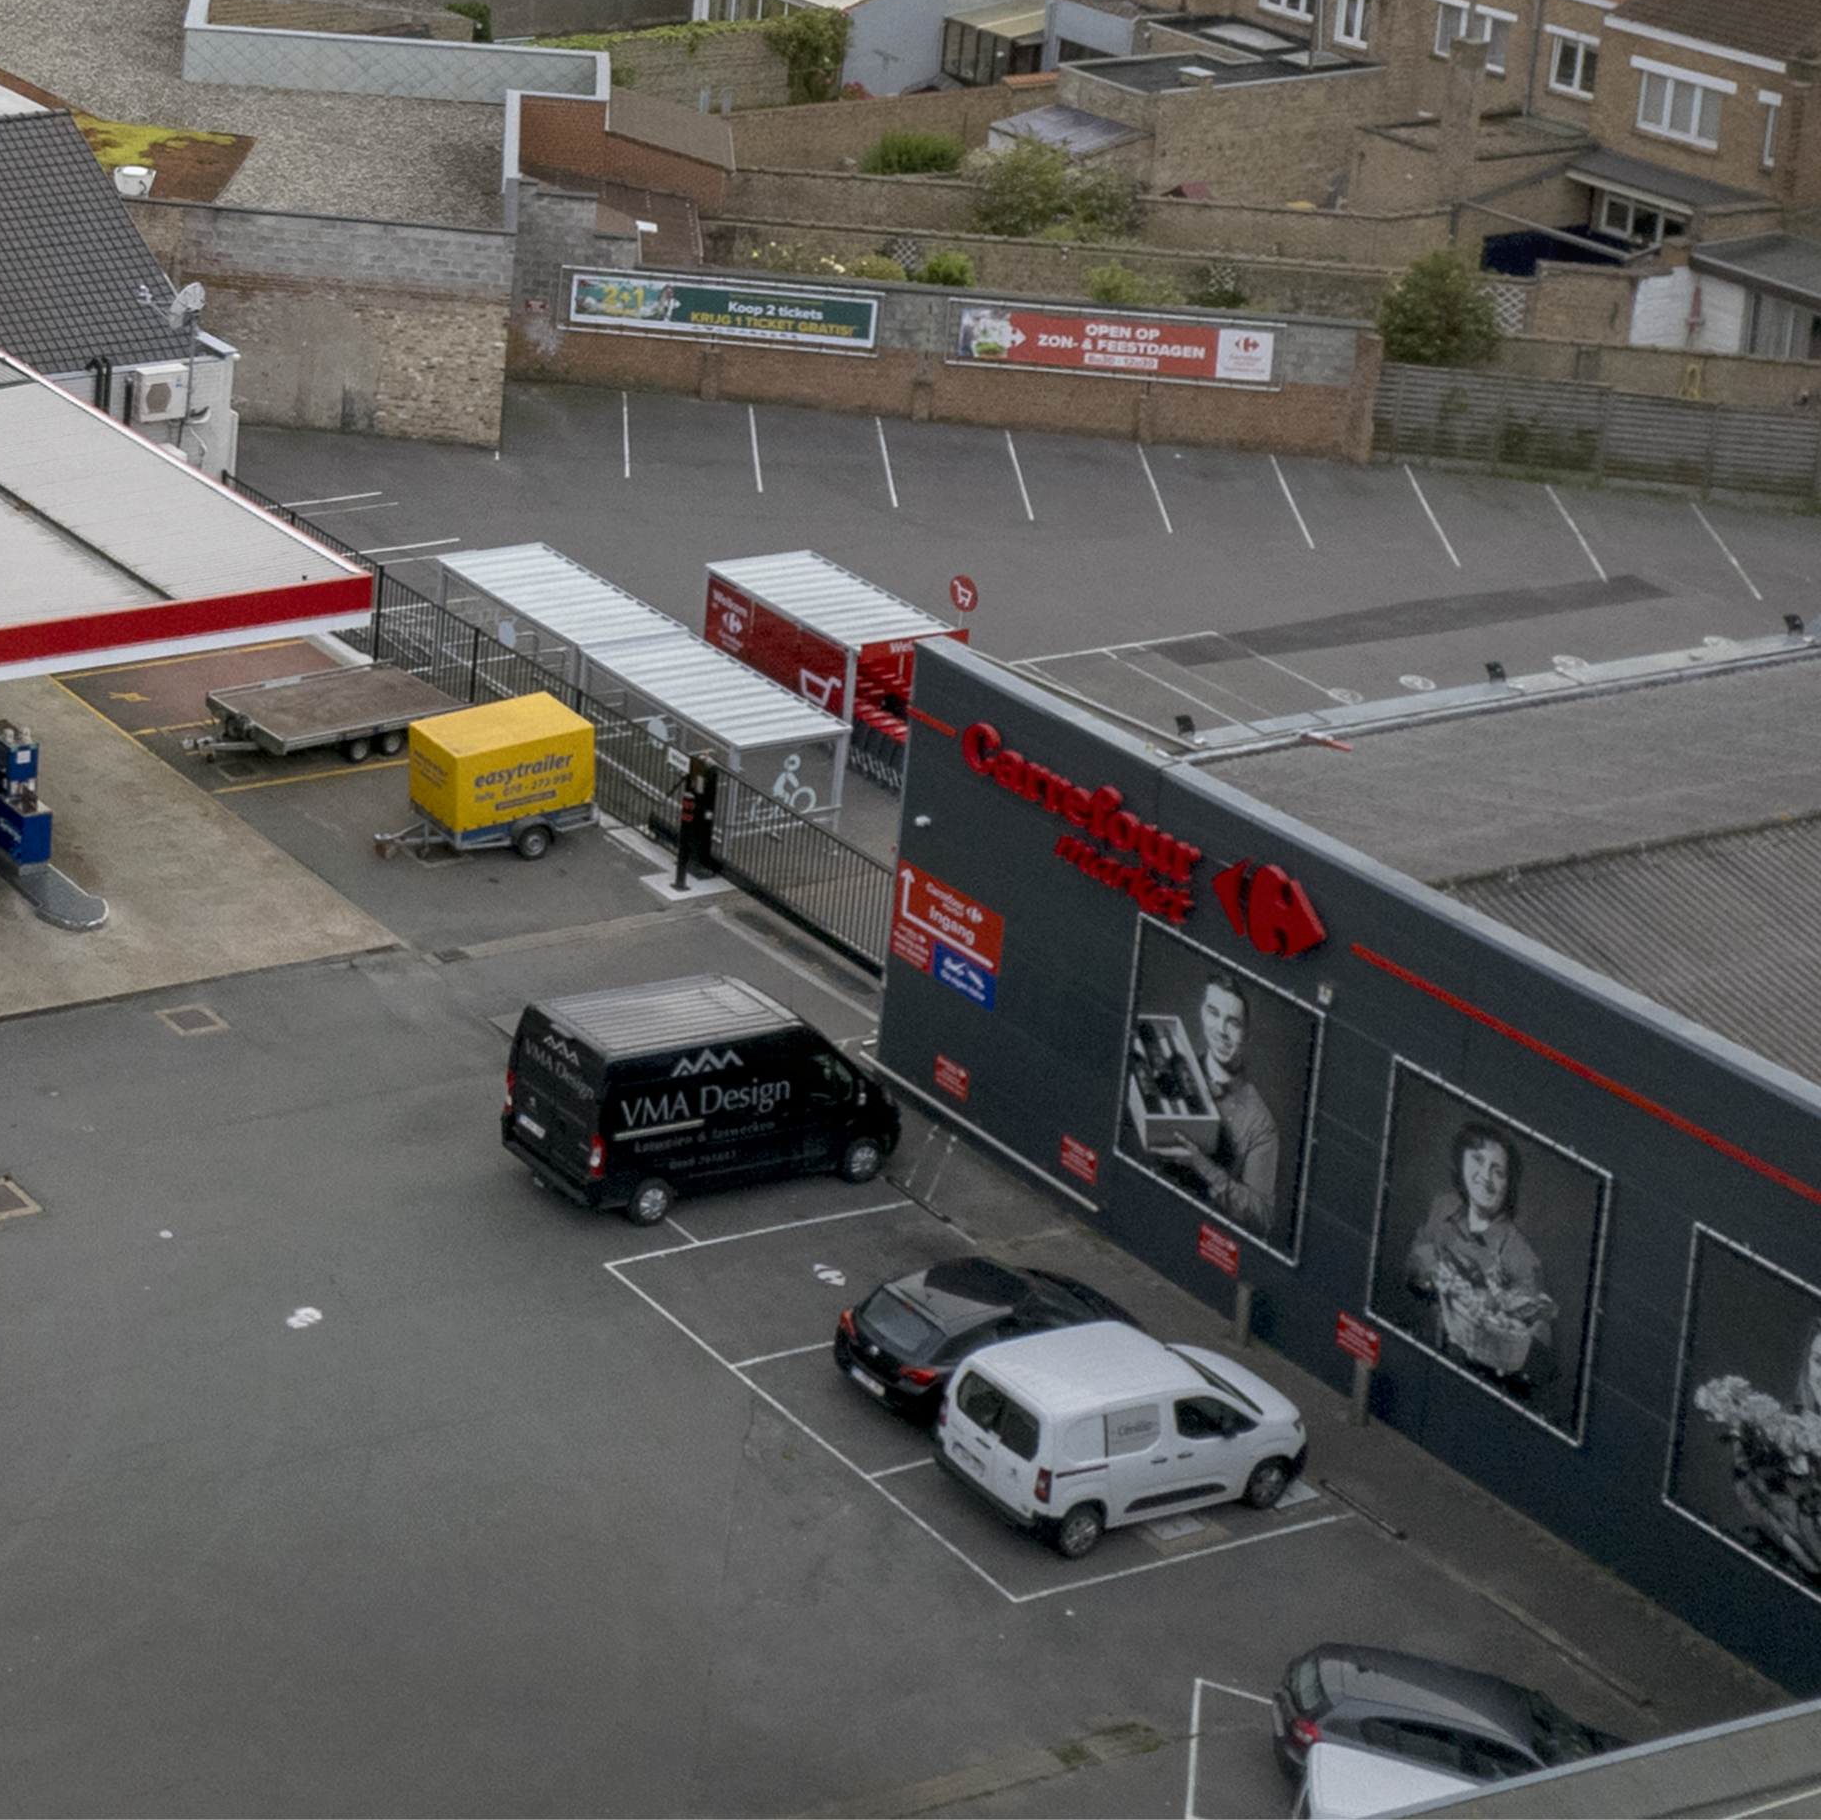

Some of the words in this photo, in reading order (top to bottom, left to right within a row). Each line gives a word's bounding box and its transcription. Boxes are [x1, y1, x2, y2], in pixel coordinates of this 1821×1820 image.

[690, 311, 731, 325] KRIJG
[735, 316, 743, 326] 1
[746, 317, 795, 332] TICKET
[728, 301, 764, 317] Koop
[766, 304, 776, 316] 2
[778, 306, 824, 321] tickets
[1037, 333, 1079, 349] ZON-
[1082, 337, 1093, 352] &
[1097, 340, 1206, 359] FEESTDAGEN
[1085, 323, 1131, 340] OPEN
[1136, 326, 1161, 341] OP
[474, 753, 574, 788] easytrailer
[962, 721, 1202, 883] Carrefour
[1054, 834, 1194, 924] market
[929, 904, 976, 947] Ingang
[554, 1061, 595, 1100] Design
[620, 1090, 692, 1129] VMA
[699, 1076, 792, 1117] Design
